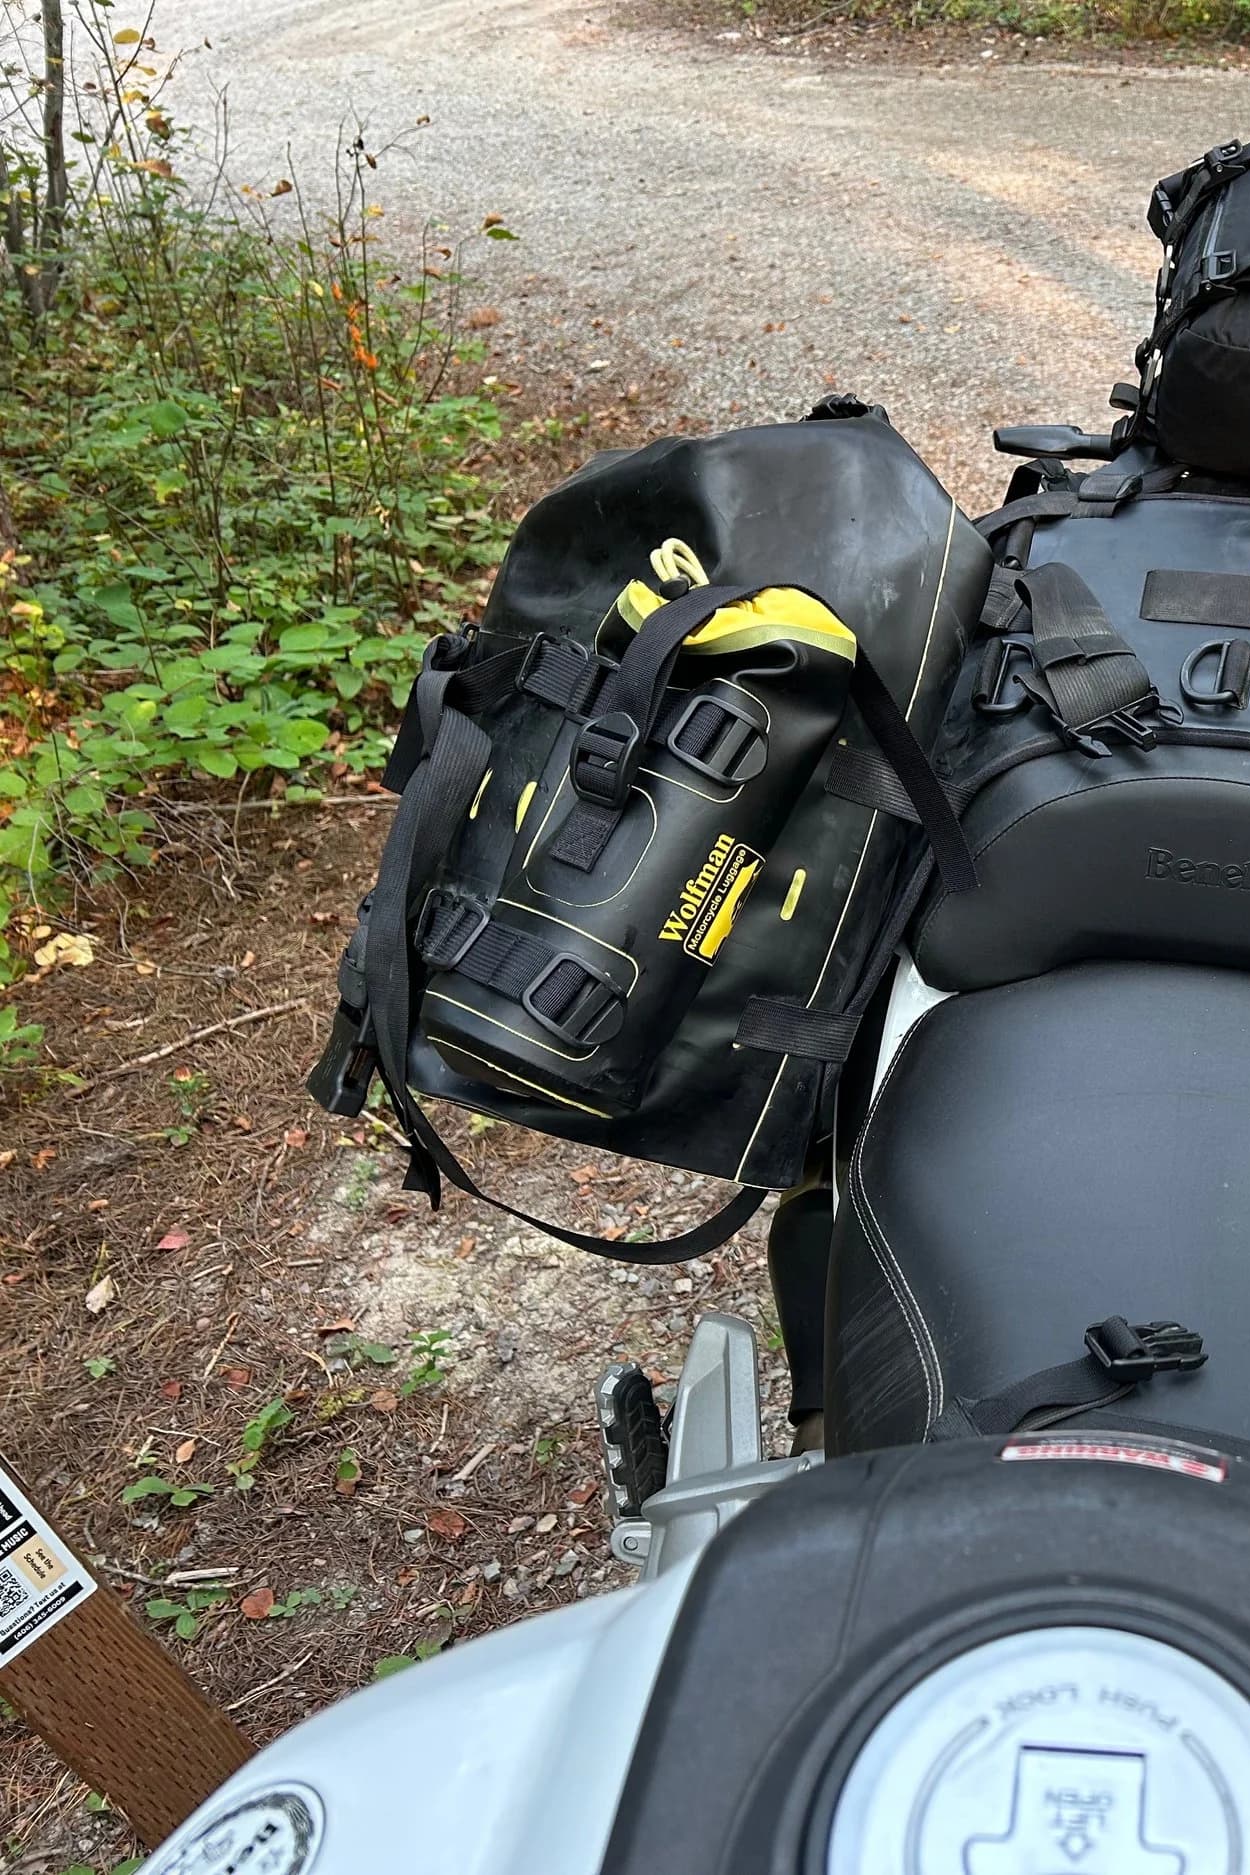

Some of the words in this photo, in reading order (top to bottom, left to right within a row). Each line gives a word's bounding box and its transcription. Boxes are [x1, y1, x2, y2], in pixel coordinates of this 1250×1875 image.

[658, 833, 736, 942] Wolfman
[687, 894, 723, 950] Motorcycle
[717, 849, 747, 894] Luggage
[0, 1527, 29, 1552] MUSIC
[23, 1552, 46, 1579] Schedule
[35, 1548, 46, 1560] See
[44, 1558, 54, 1570] the
[0, 1605, 35, 1637] Questions?
[34, 1594, 50, 1608] Text
[48, 1588, 59, 1597] us
[57, 1581, 66, 1590] at
[13, 1622, 34, 1640] (406)
[993, 1682, 1079, 1720] LOCK
[1099, 1685, 1179, 1732] PUSH
